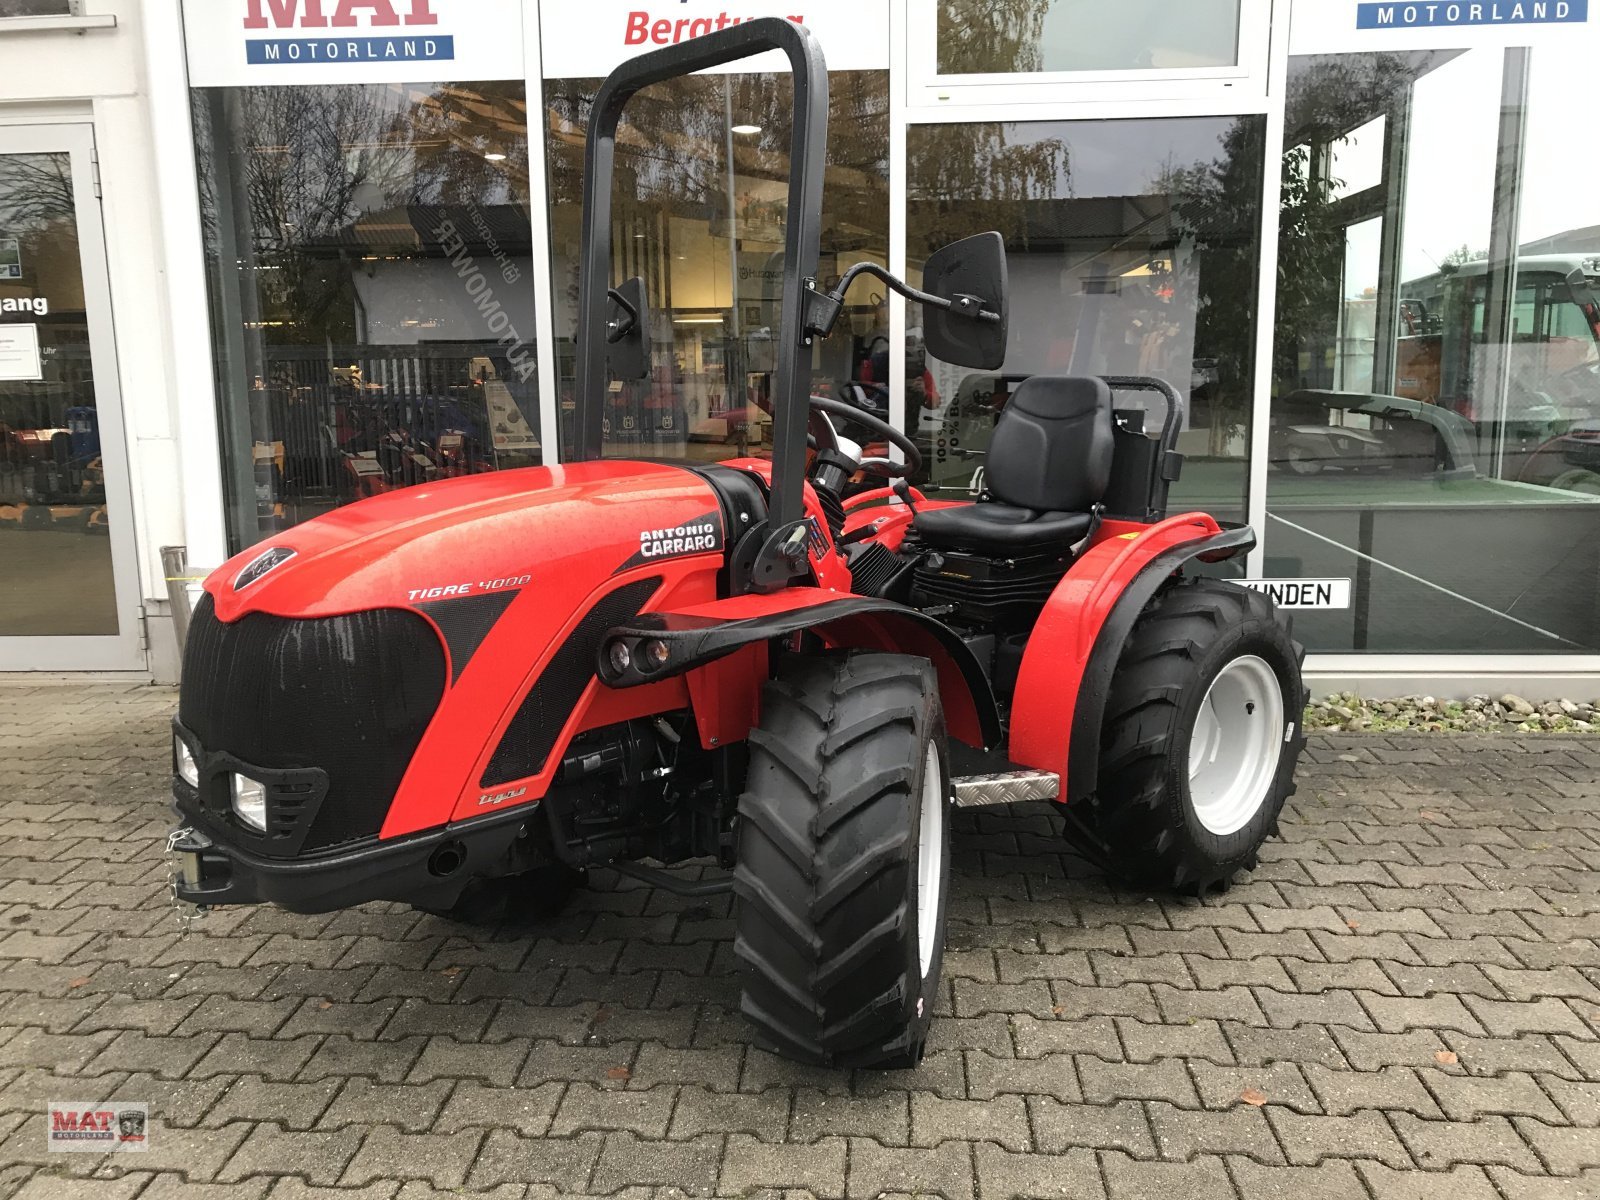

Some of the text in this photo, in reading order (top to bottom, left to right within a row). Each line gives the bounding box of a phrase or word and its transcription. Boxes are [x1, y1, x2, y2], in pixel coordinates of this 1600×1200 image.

[1377, 2, 1569, 23] MOTORLAND
[624, 11, 804, 45] Berat
[264, 40, 437, 60] MOTORLAND
[0, 297, 48, 315] ang
[43, 346, 57, 355] Uhr
[937, 439, 947, 463] 100
[640, 523, 714, 541] ANTONIO
[640, 534, 715, 557] CARRARO
[408, 574, 531, 601] TIGRE 4000
[1246, 583, 1332, 605] NDEN
